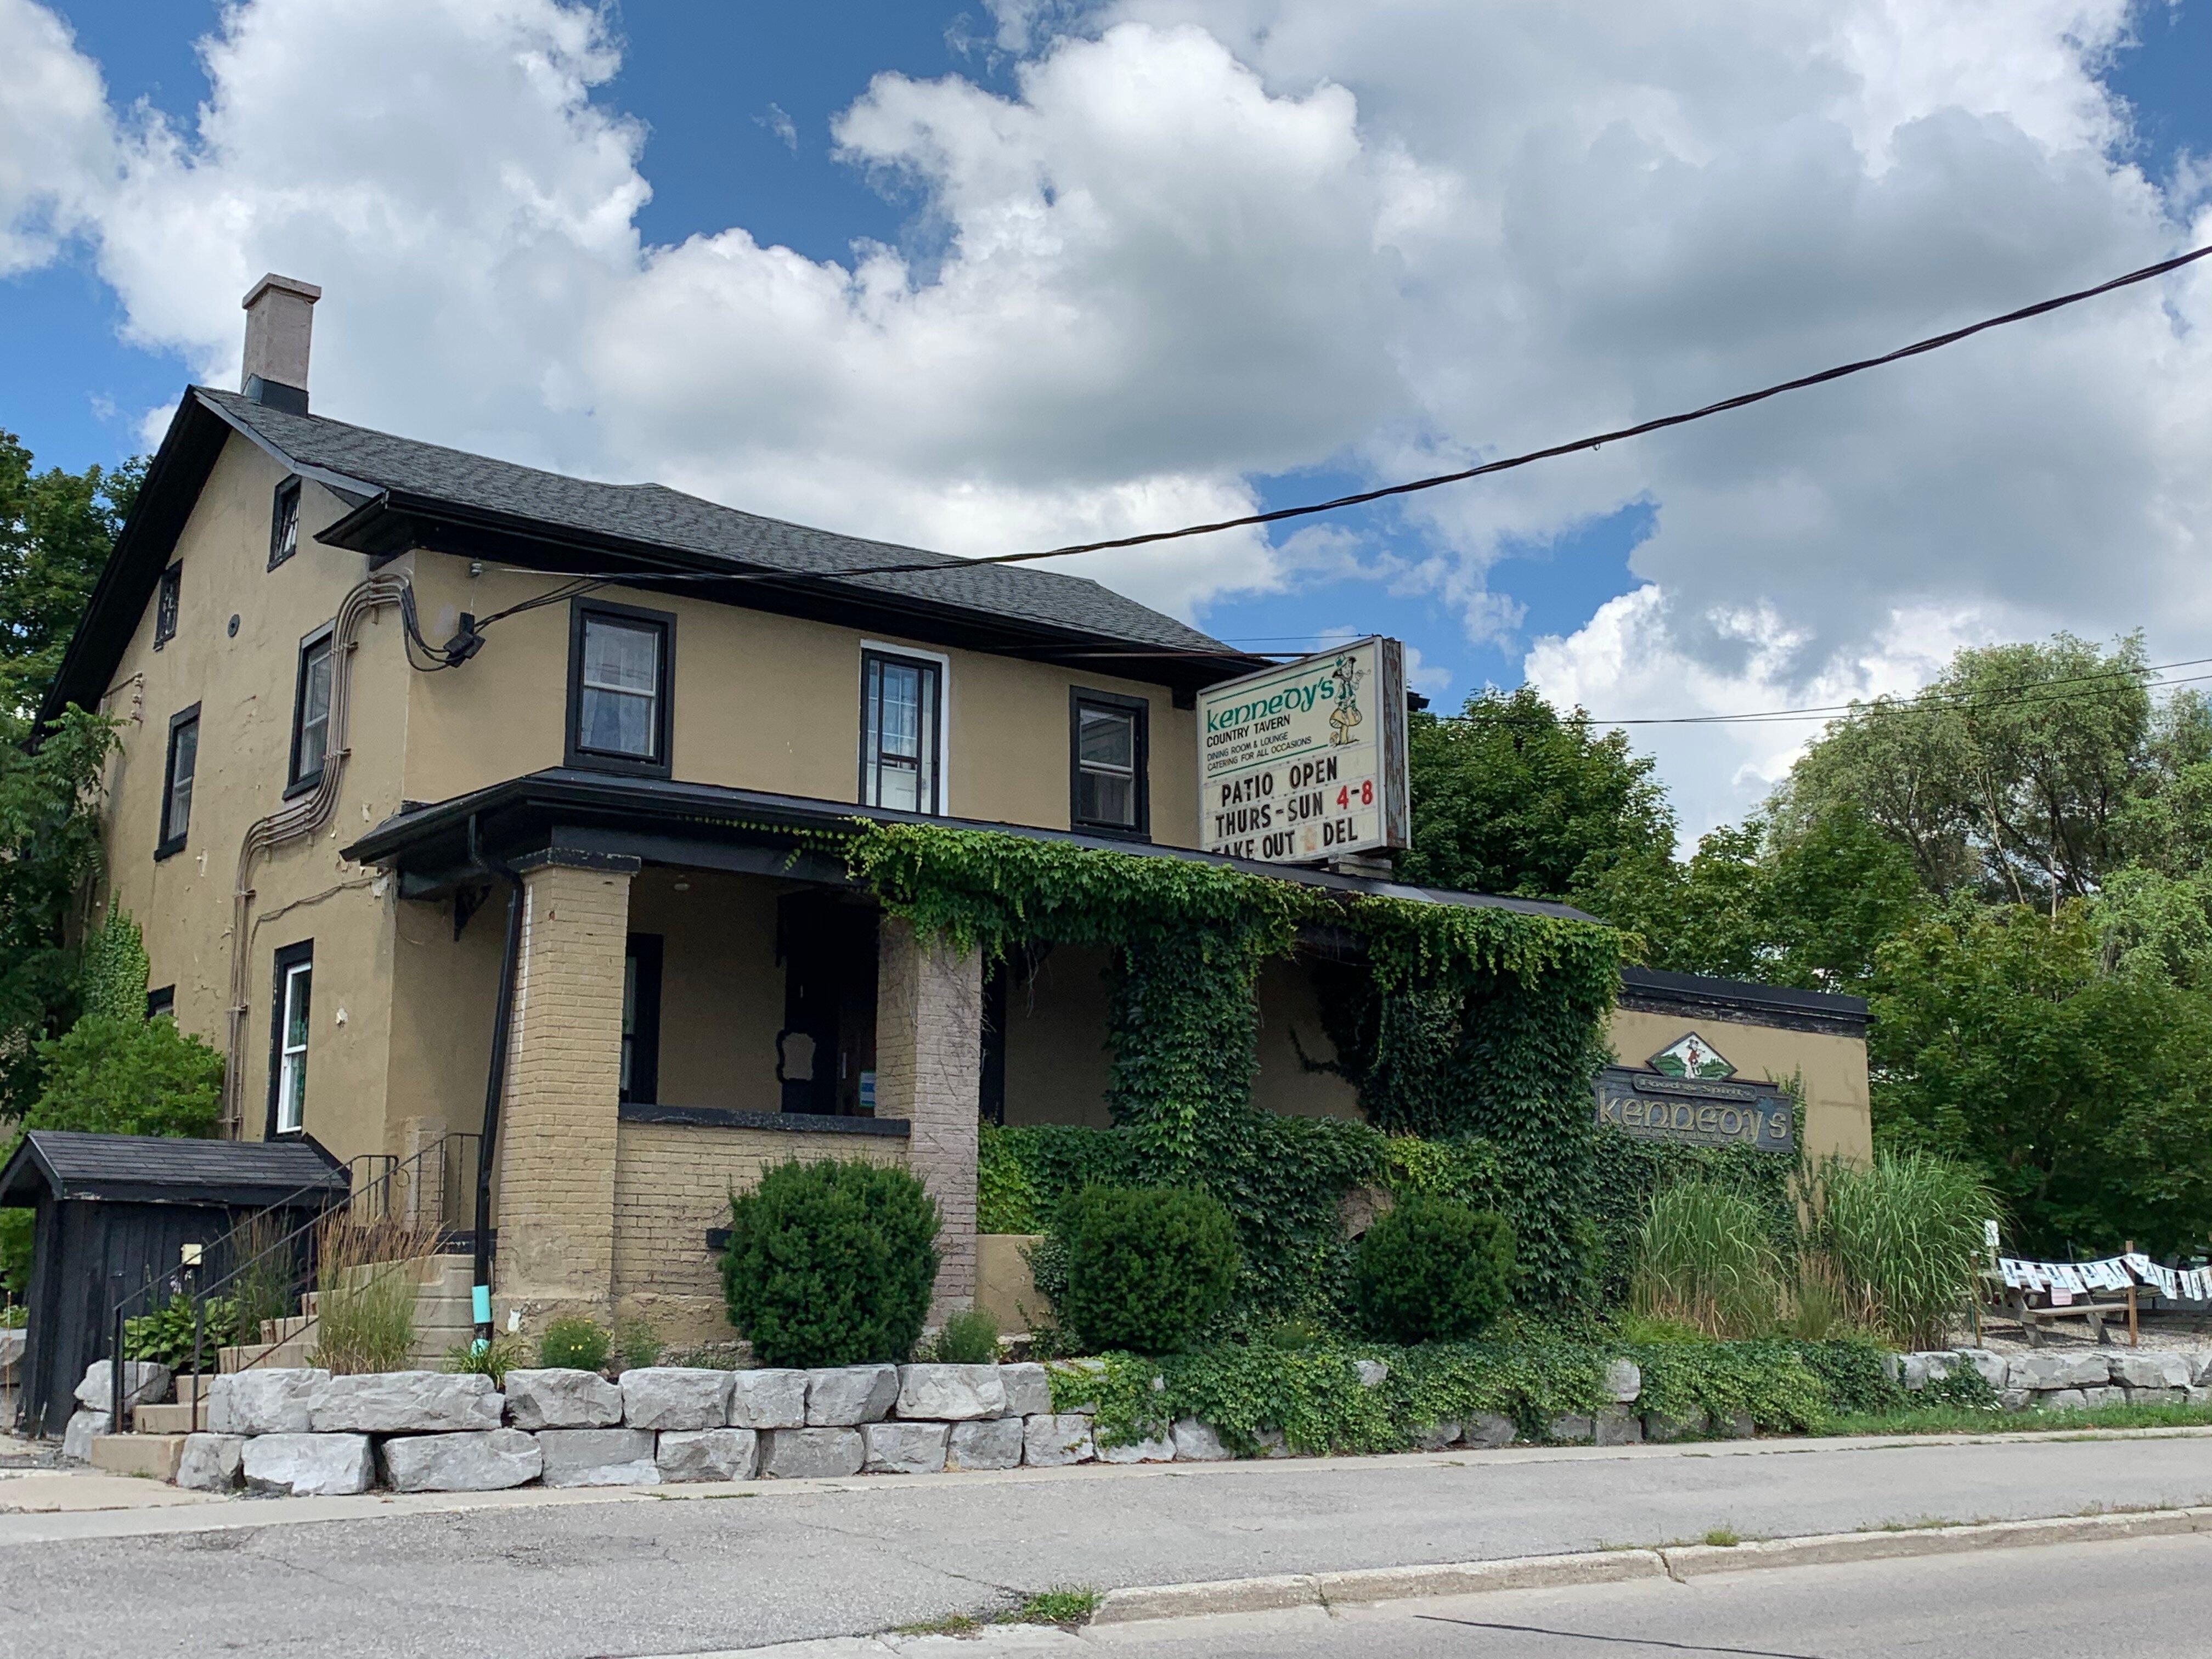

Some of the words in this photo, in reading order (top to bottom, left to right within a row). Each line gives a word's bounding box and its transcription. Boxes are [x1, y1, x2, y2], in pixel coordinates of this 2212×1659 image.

[1207, 725, 1250, 748] COUNTRY
[1254, 714, 1290, 734] TAVERN
[1207, 749, 1229, 762] DINING
[1231, 743, 1251, 754] ROOM
[1253, 740, 1257, 748] &
[1261, 732, 1288, 747] LOUNGE
[1207, 757, 1238, 771] CATERING
[1241, 753, 1254, 762] FOR
[1257, 748, 1269, 757] ALL
[1271, 736, 1312, 754] OCCASIONS
[1222, 772, 1273, 808] PATIO
[1289, 756, 1337, 789] OPEN
[1336, 780, 1373, 810] 4-8
[1211, 839, 1255, 859] AKE
[1262, 830, 1295, 859] OUT
[1323, 817, 1358, 847] DEL
[1640, 1079, 1680, 1089] Food
